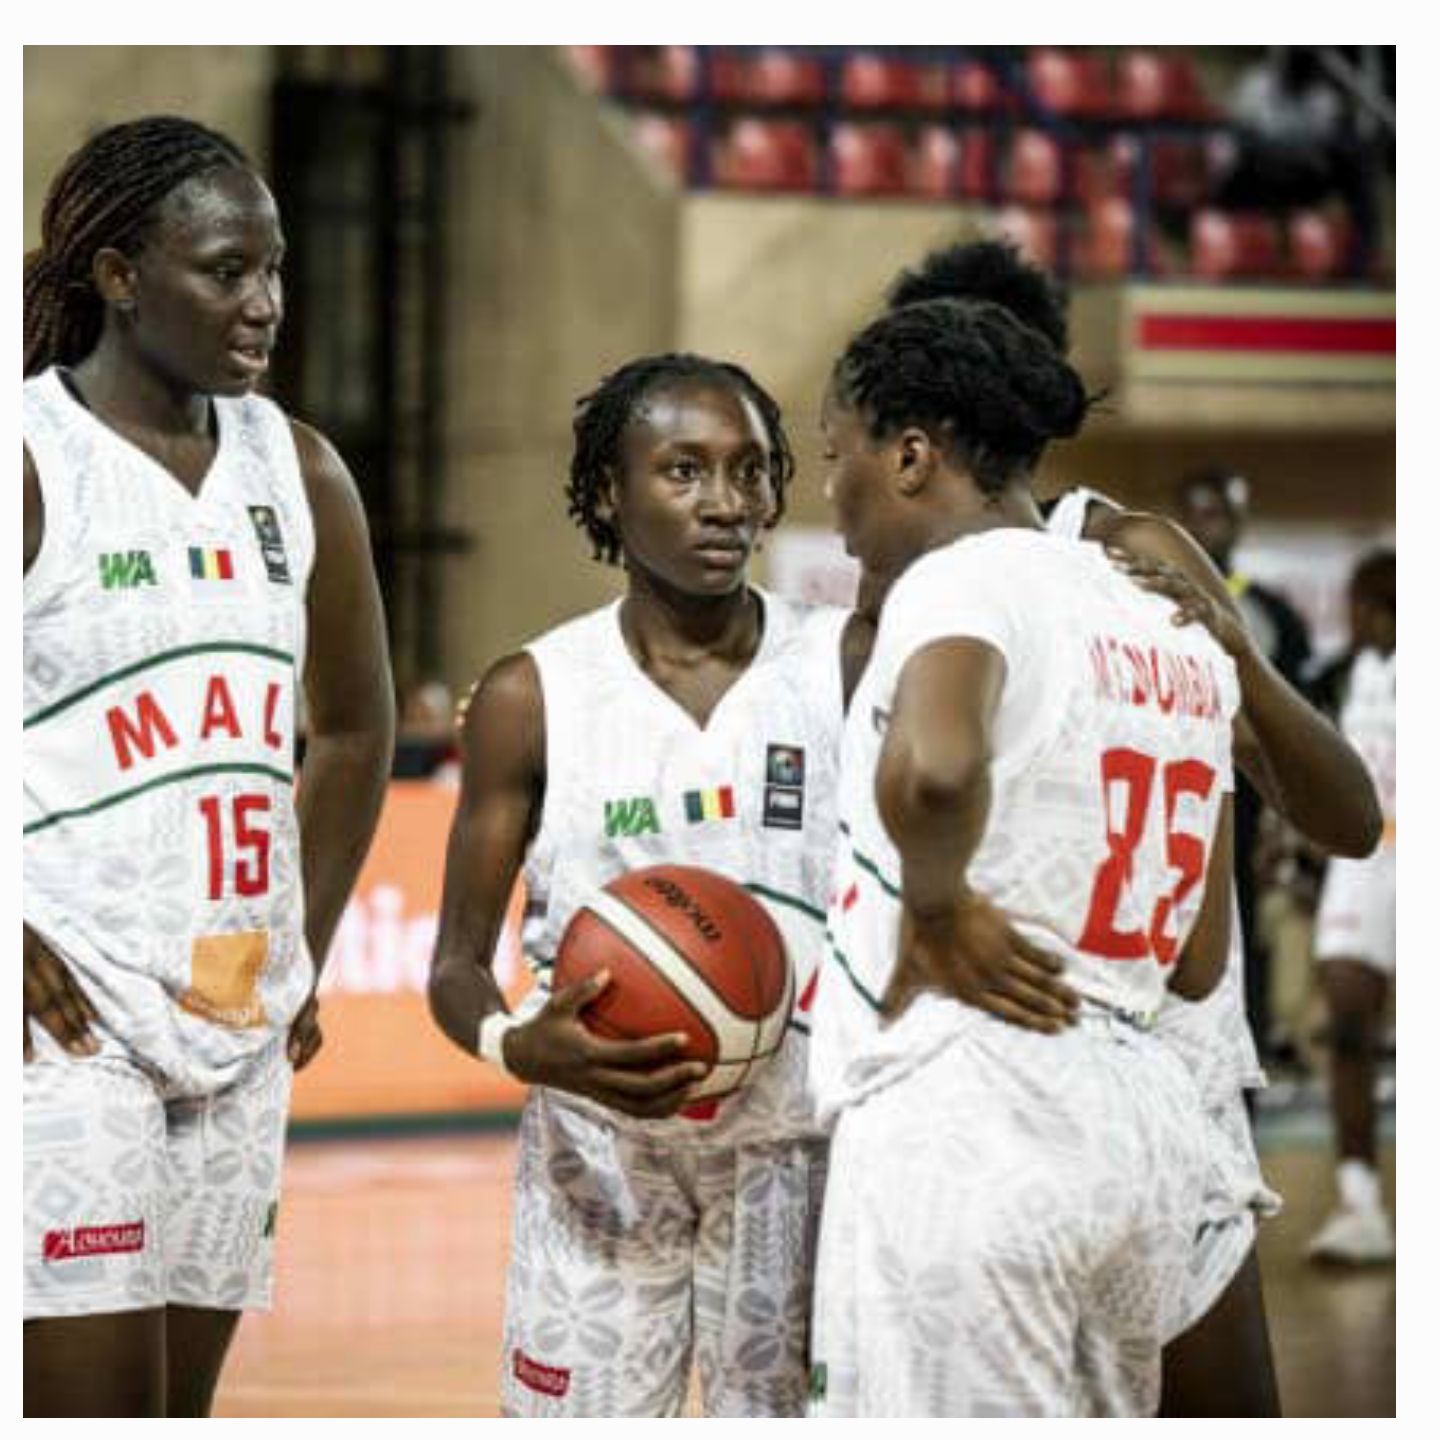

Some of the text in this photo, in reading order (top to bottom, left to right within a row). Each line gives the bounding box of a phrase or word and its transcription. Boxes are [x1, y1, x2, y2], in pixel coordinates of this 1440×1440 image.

[98, 549, 157, 590] WA
[604, 796, 661, 837] WA
[198, 794, 272, 901] 15
